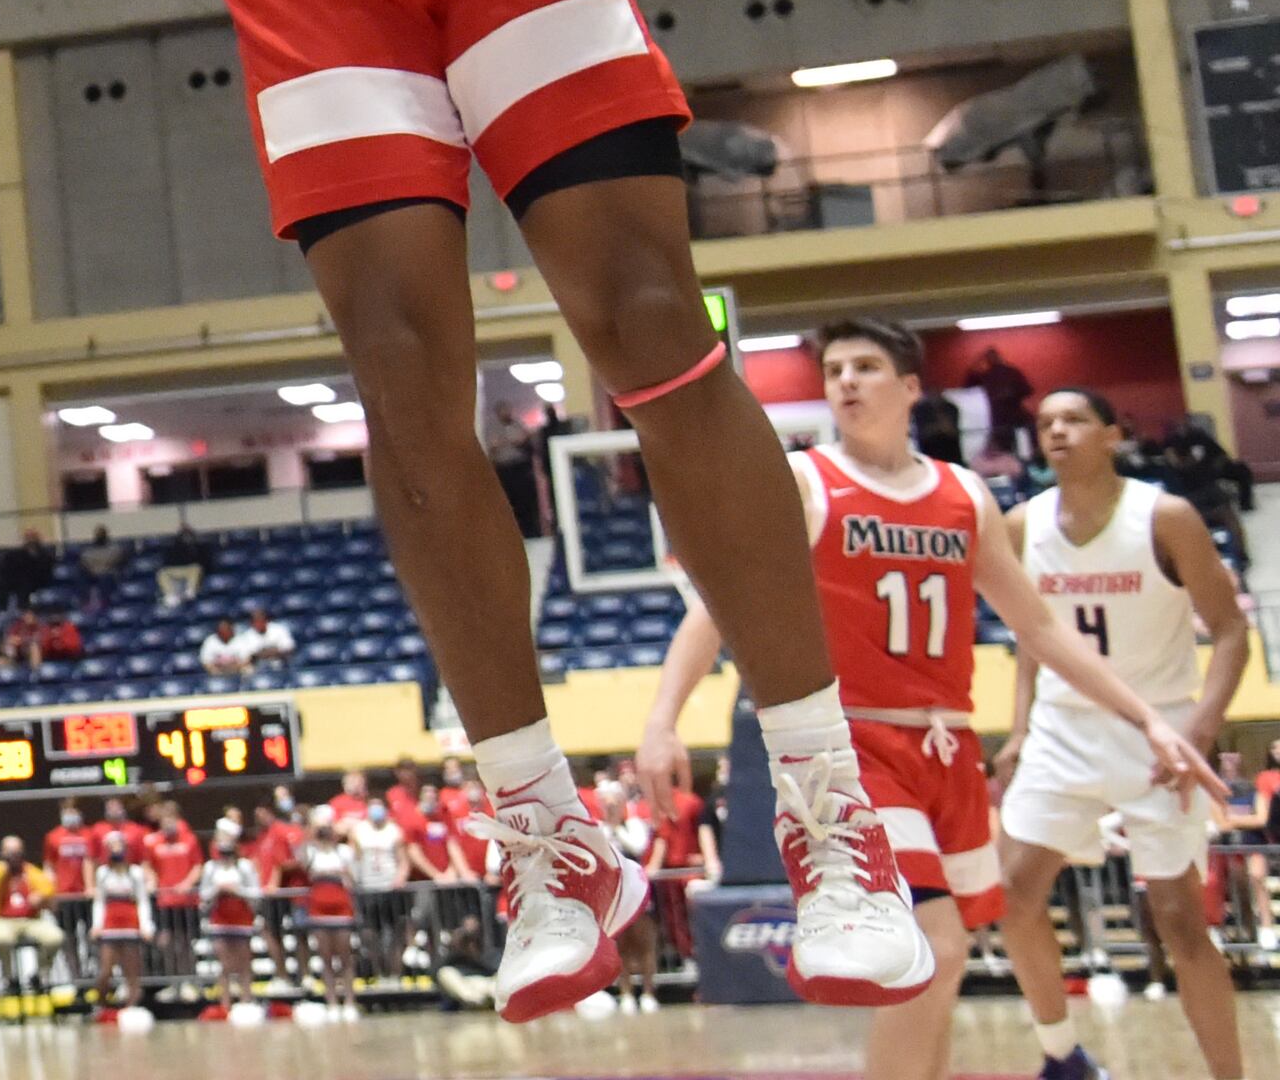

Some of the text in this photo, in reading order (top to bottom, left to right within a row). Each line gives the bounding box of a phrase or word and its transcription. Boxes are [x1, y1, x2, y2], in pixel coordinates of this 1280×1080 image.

[842, 514, 968, 565] MILTON
[875, 570, 948, 658] 11
[1075, 604, 1109, 657] 4
[158, 730, 205, 769] 41
